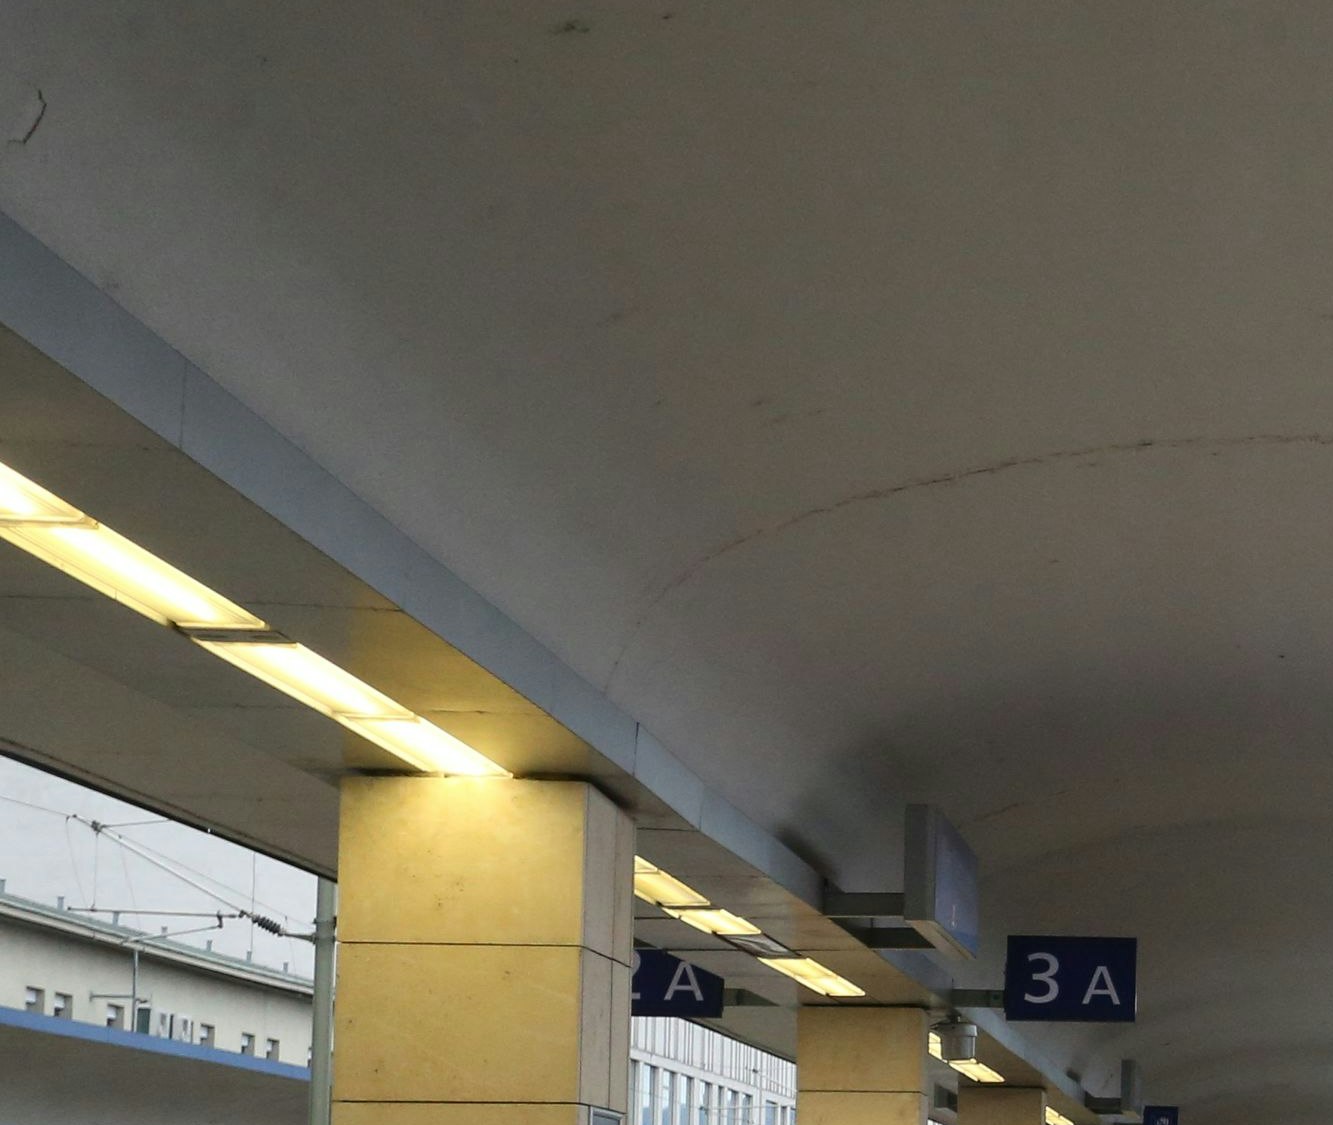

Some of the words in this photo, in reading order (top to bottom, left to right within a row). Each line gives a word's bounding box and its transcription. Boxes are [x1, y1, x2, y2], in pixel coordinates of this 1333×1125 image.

[663, 960, 705, 1001] A
[1024, 951, 1060, 1004] 3
[1081, 965, 1121, 1005] A
